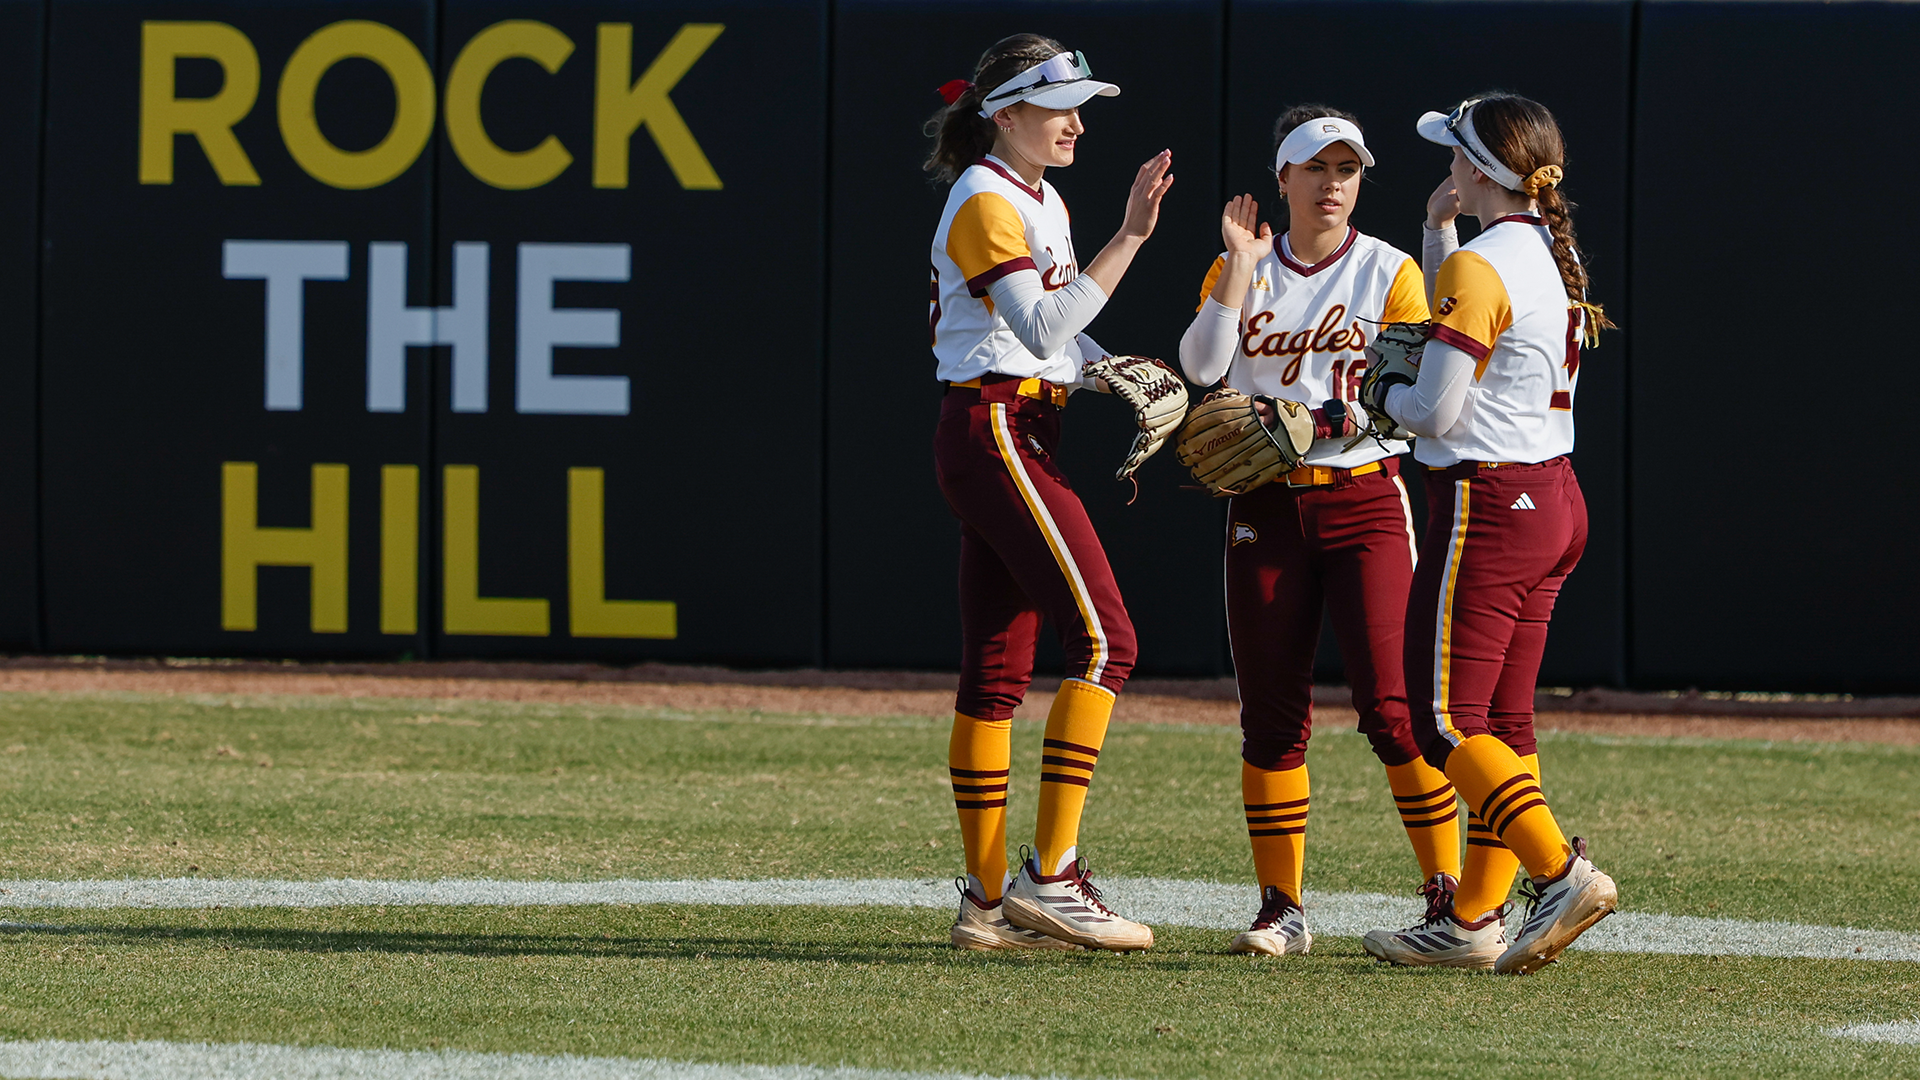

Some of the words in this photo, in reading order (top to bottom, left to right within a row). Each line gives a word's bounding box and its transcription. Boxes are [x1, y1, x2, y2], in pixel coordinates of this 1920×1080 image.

[139, 21, 724, 189] ROCK
[223, 241, 630, 414] THE
[1242, 304, 1366, 387] Eagles
[222, 462, 677, 638] HILL
